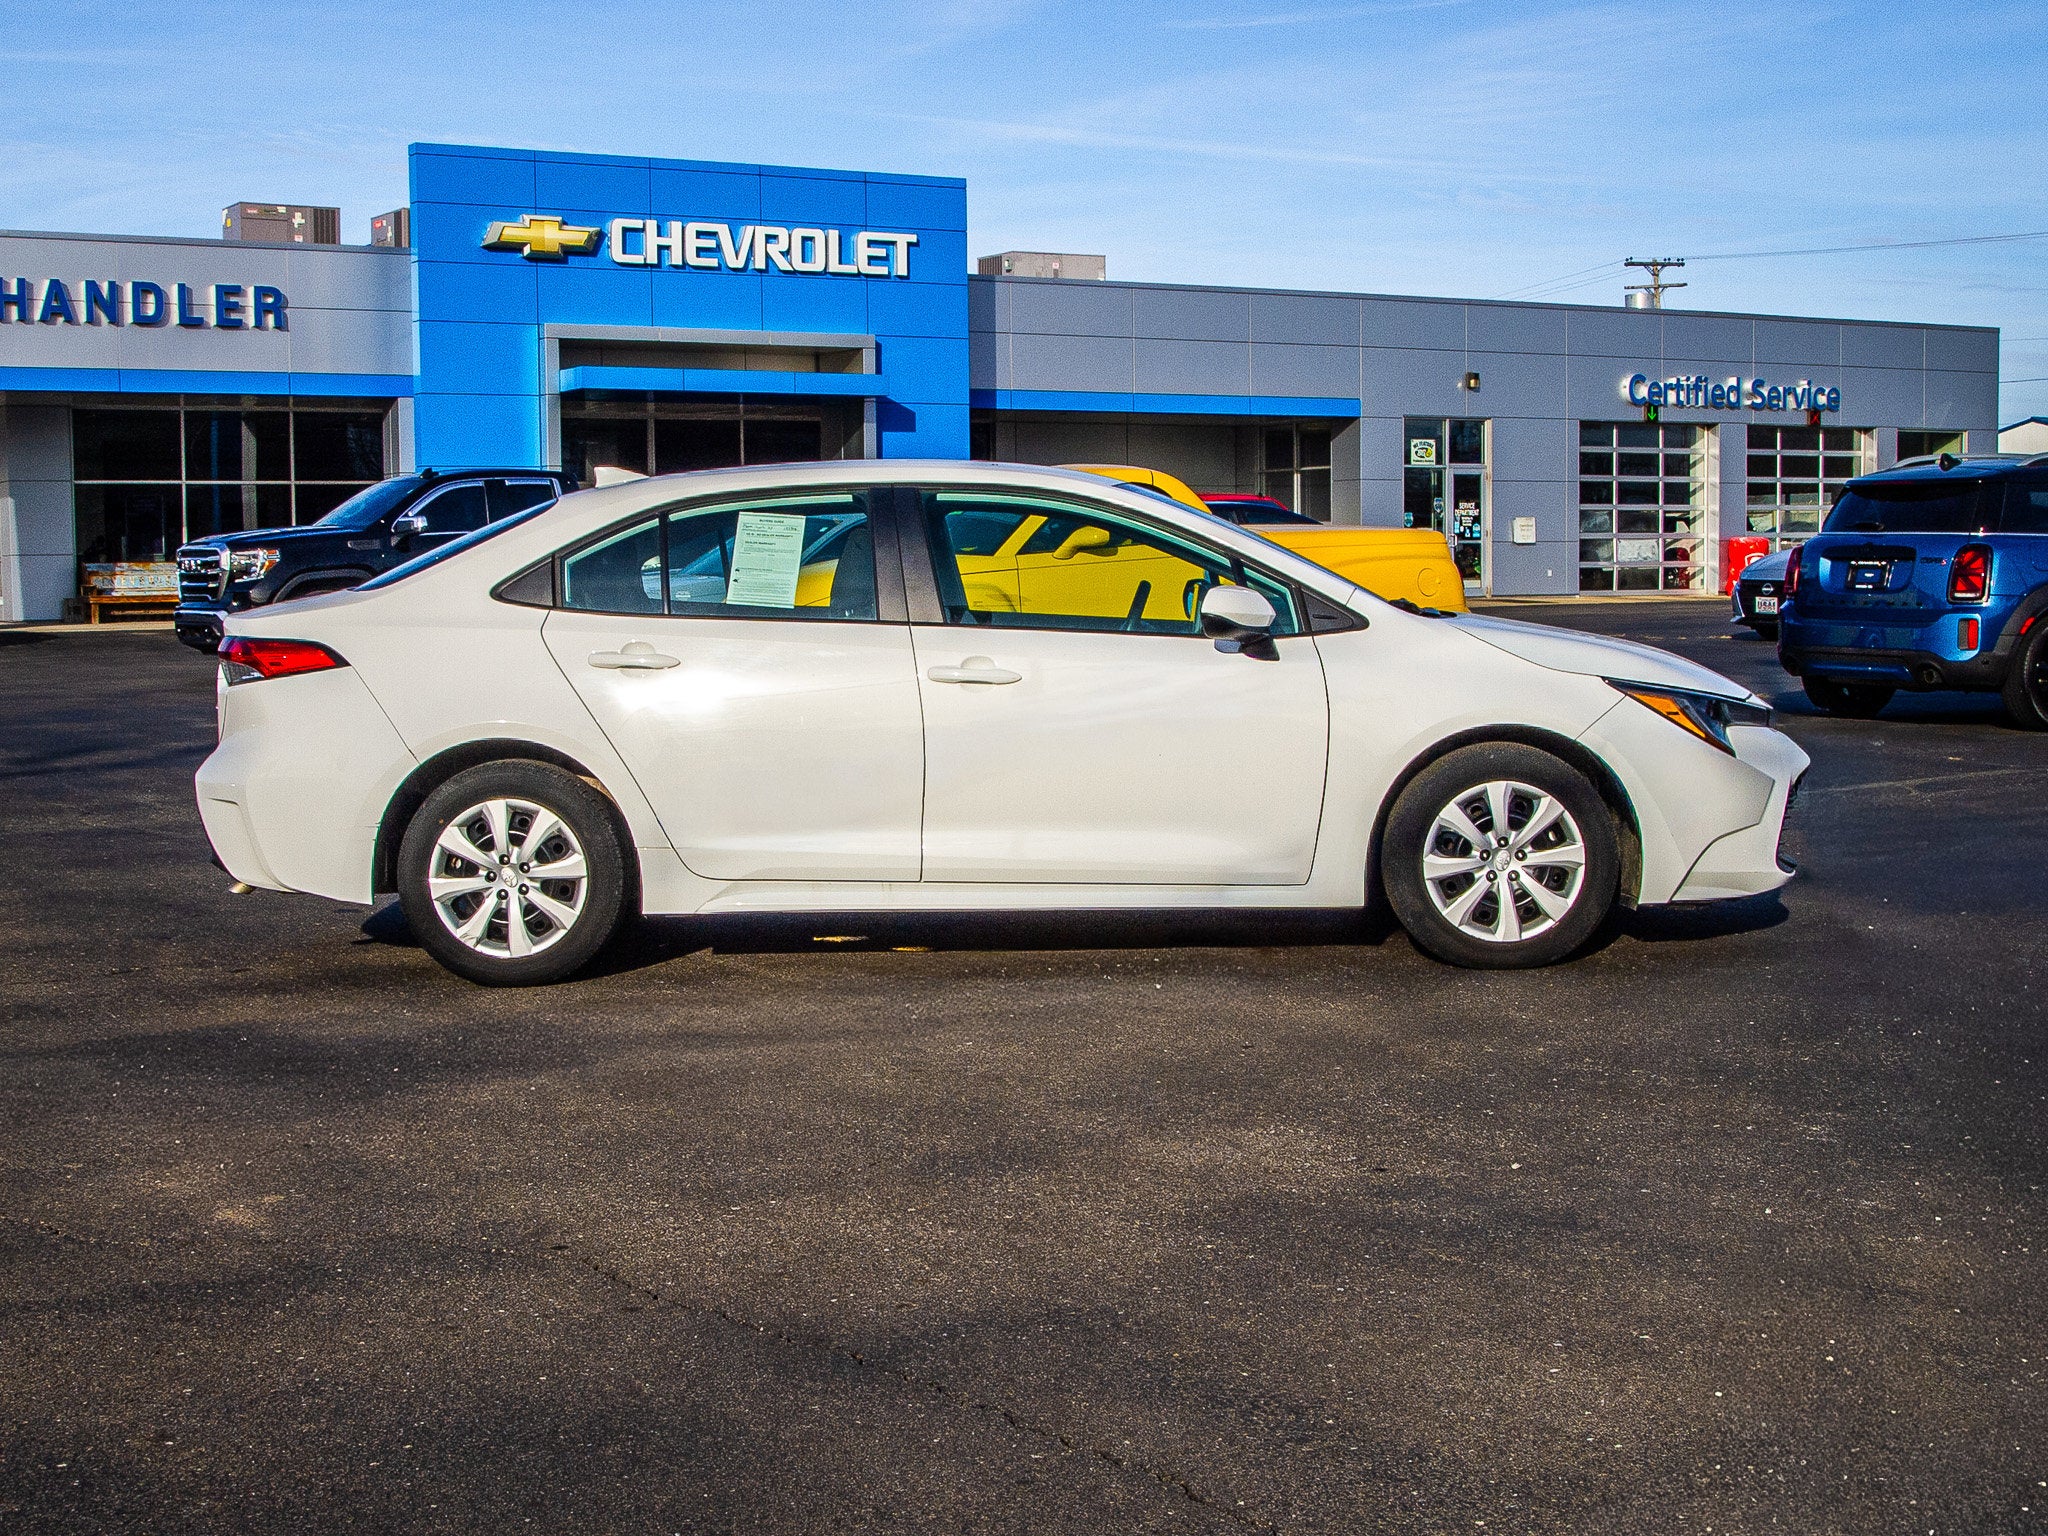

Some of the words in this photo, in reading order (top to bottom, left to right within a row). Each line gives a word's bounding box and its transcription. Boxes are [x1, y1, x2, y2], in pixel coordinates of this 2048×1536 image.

[609, 218, 918, 277] CHEVROLET
[0, 276, 287, 329] HANDLER
[1629, 373, 1742, 408] Certified
[1751, 378, 1841, 412] Service
